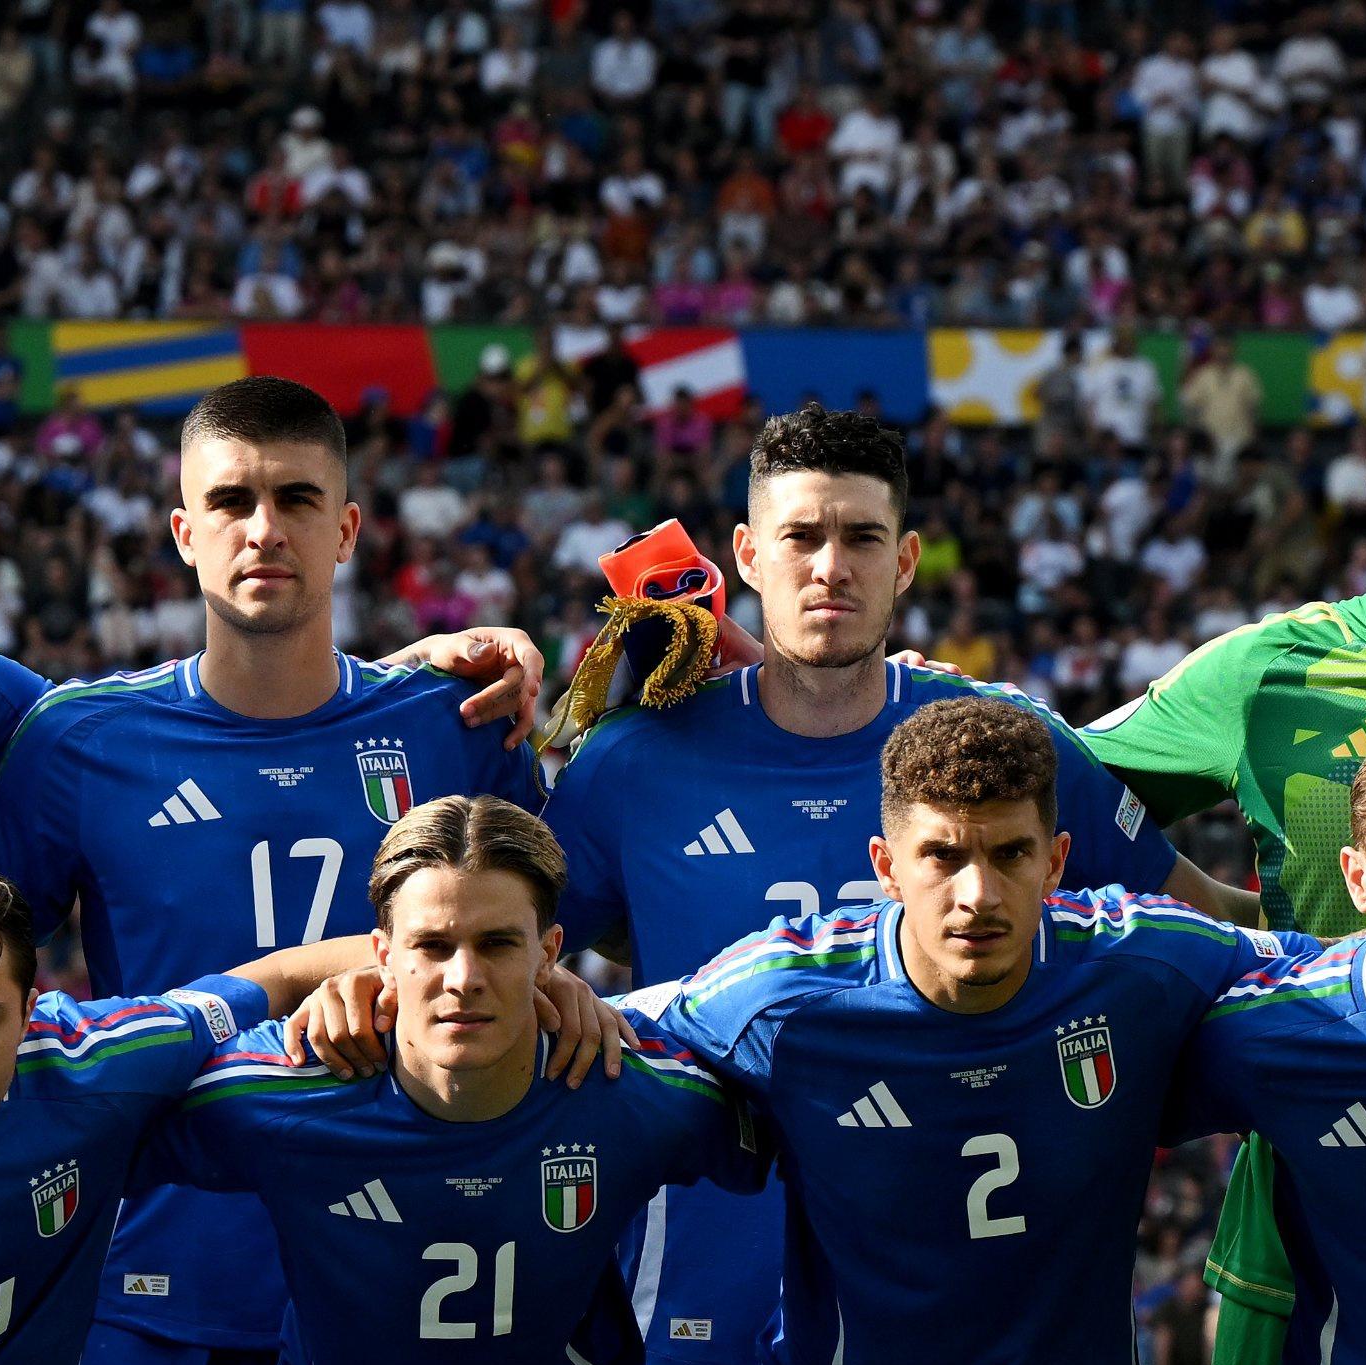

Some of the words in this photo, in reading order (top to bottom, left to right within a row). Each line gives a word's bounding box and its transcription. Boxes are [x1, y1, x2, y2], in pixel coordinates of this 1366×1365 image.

[361, 756, 403, 771] ITALIA
[251, 837, 344, 948] 17
[1061, 1034, 1107, 1057] ITALIA
[546, 1163, 592, 1180] ITALIA
[961, 1133, 1026, 1239] 2
[37, 1174, 75, 1204] ITALIA
[419, 1240, 516, 1340] 21
